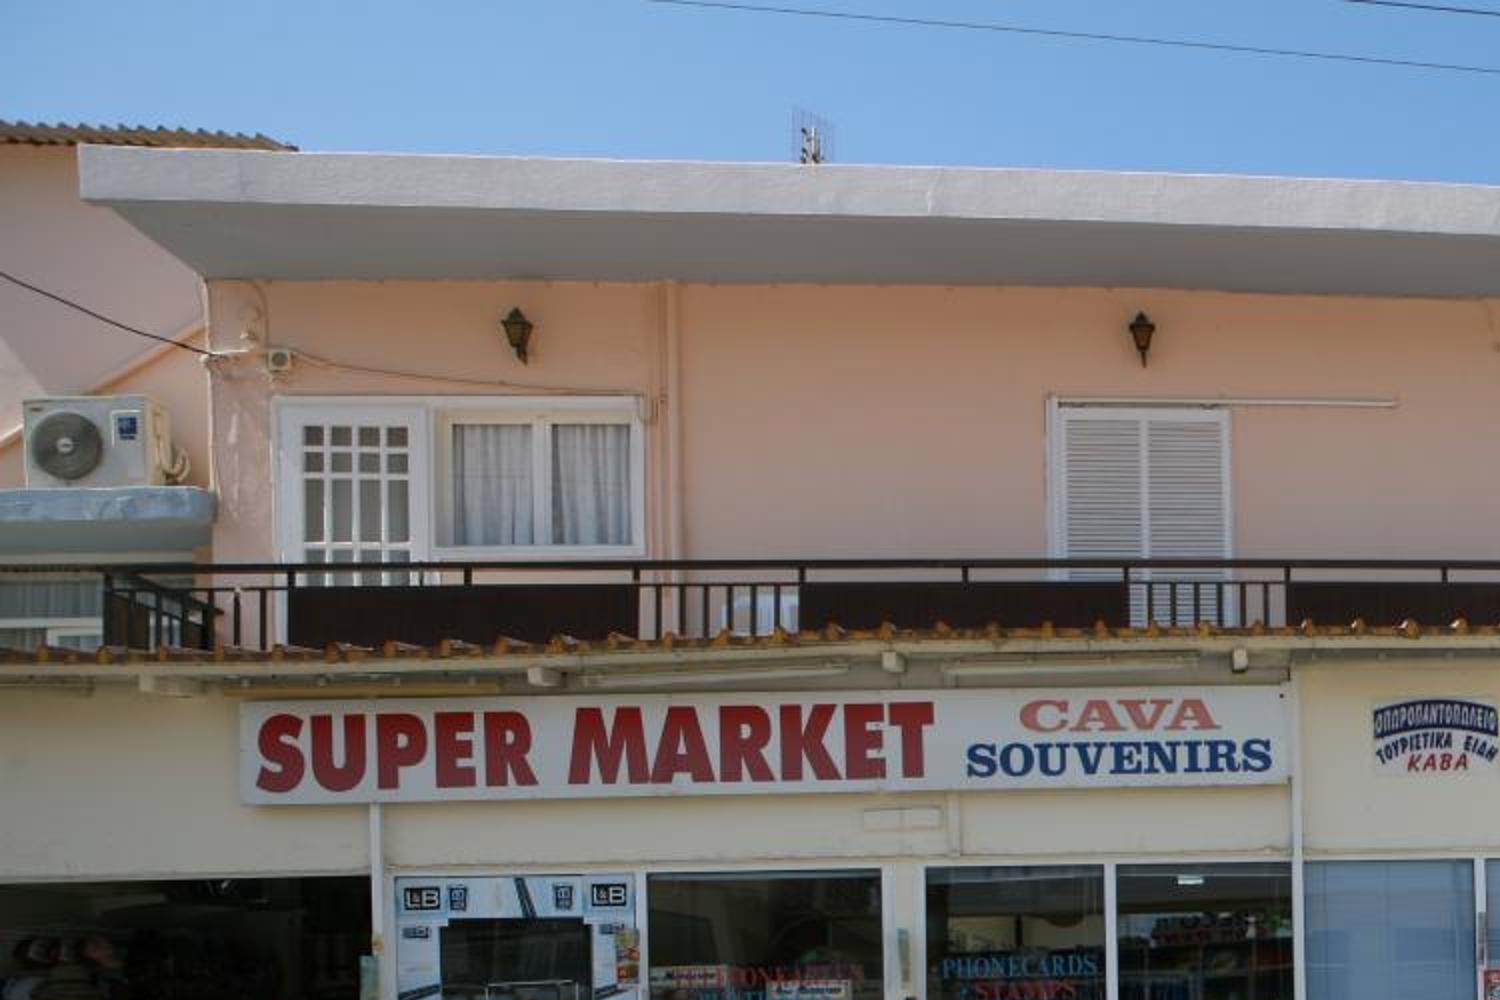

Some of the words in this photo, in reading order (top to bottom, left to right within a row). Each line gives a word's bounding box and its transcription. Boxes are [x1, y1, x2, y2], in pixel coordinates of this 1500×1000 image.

[1019, 698, 1221, 733] CAVA
[256, 711, 539, 793] SUPER
[567, 701, 935, 786] MARKET
[966, 738, 1272, 778] SOUVENIRS
[1463, 735, 1499, 763] ΕΙΔΗ
[943, 954, 1097, 978] PHONECARDS
